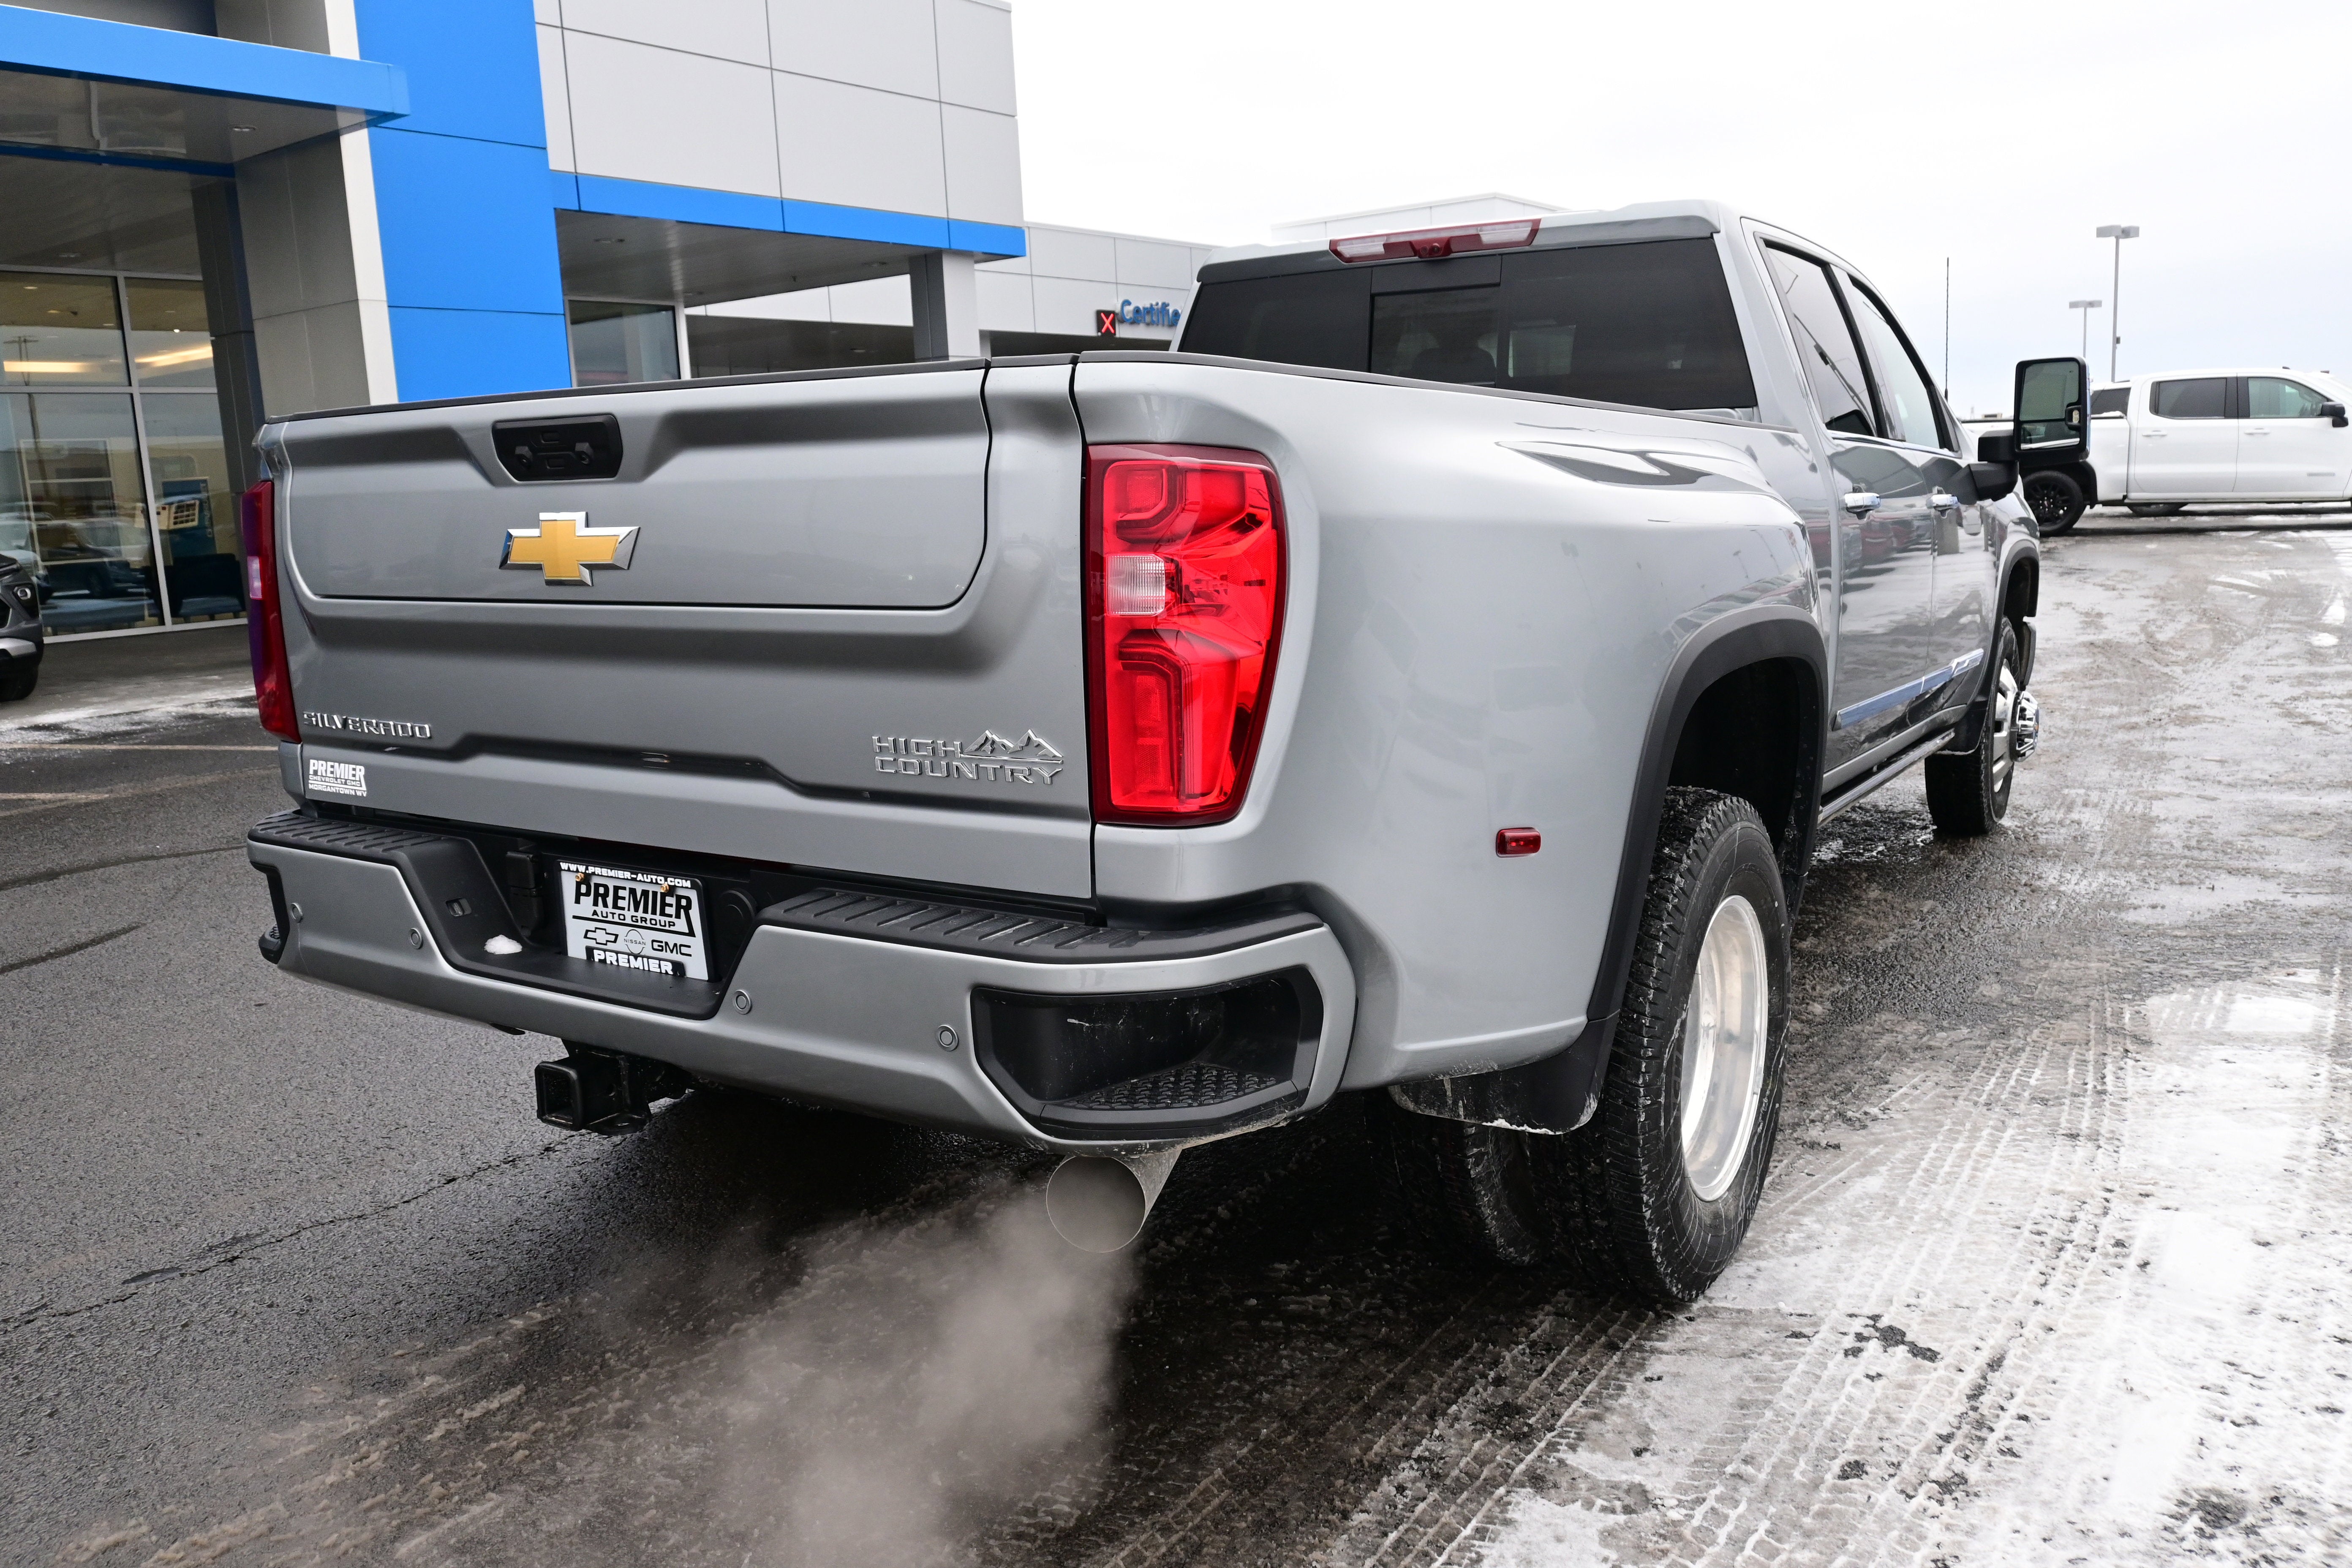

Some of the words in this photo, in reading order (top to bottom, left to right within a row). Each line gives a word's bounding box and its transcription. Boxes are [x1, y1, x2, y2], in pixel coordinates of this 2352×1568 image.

[1121, 299, 1181, 327] Certifie
[302, 711, 431, 738] SILVERADO
[872, 736, 964, 758] HIGH
[309, 759, 365, 781] PREMIER
[309, 775, 345, 784] CHEVROLET
[874, 756, 1063, 784] COUNTRY
[308, 783, 355, 795] MORGANTOWN
[560, 862, 691, 888] WWW.PREMIER-AUTO.COM
[574, 880, 694, 925] PREMIER
[591, 909, 626, 921] AUTO
[631, 915, 675, 928] GROUP
[651, 939, 692, 957] GMC
[593, 949, 673, 975] PREMIER
